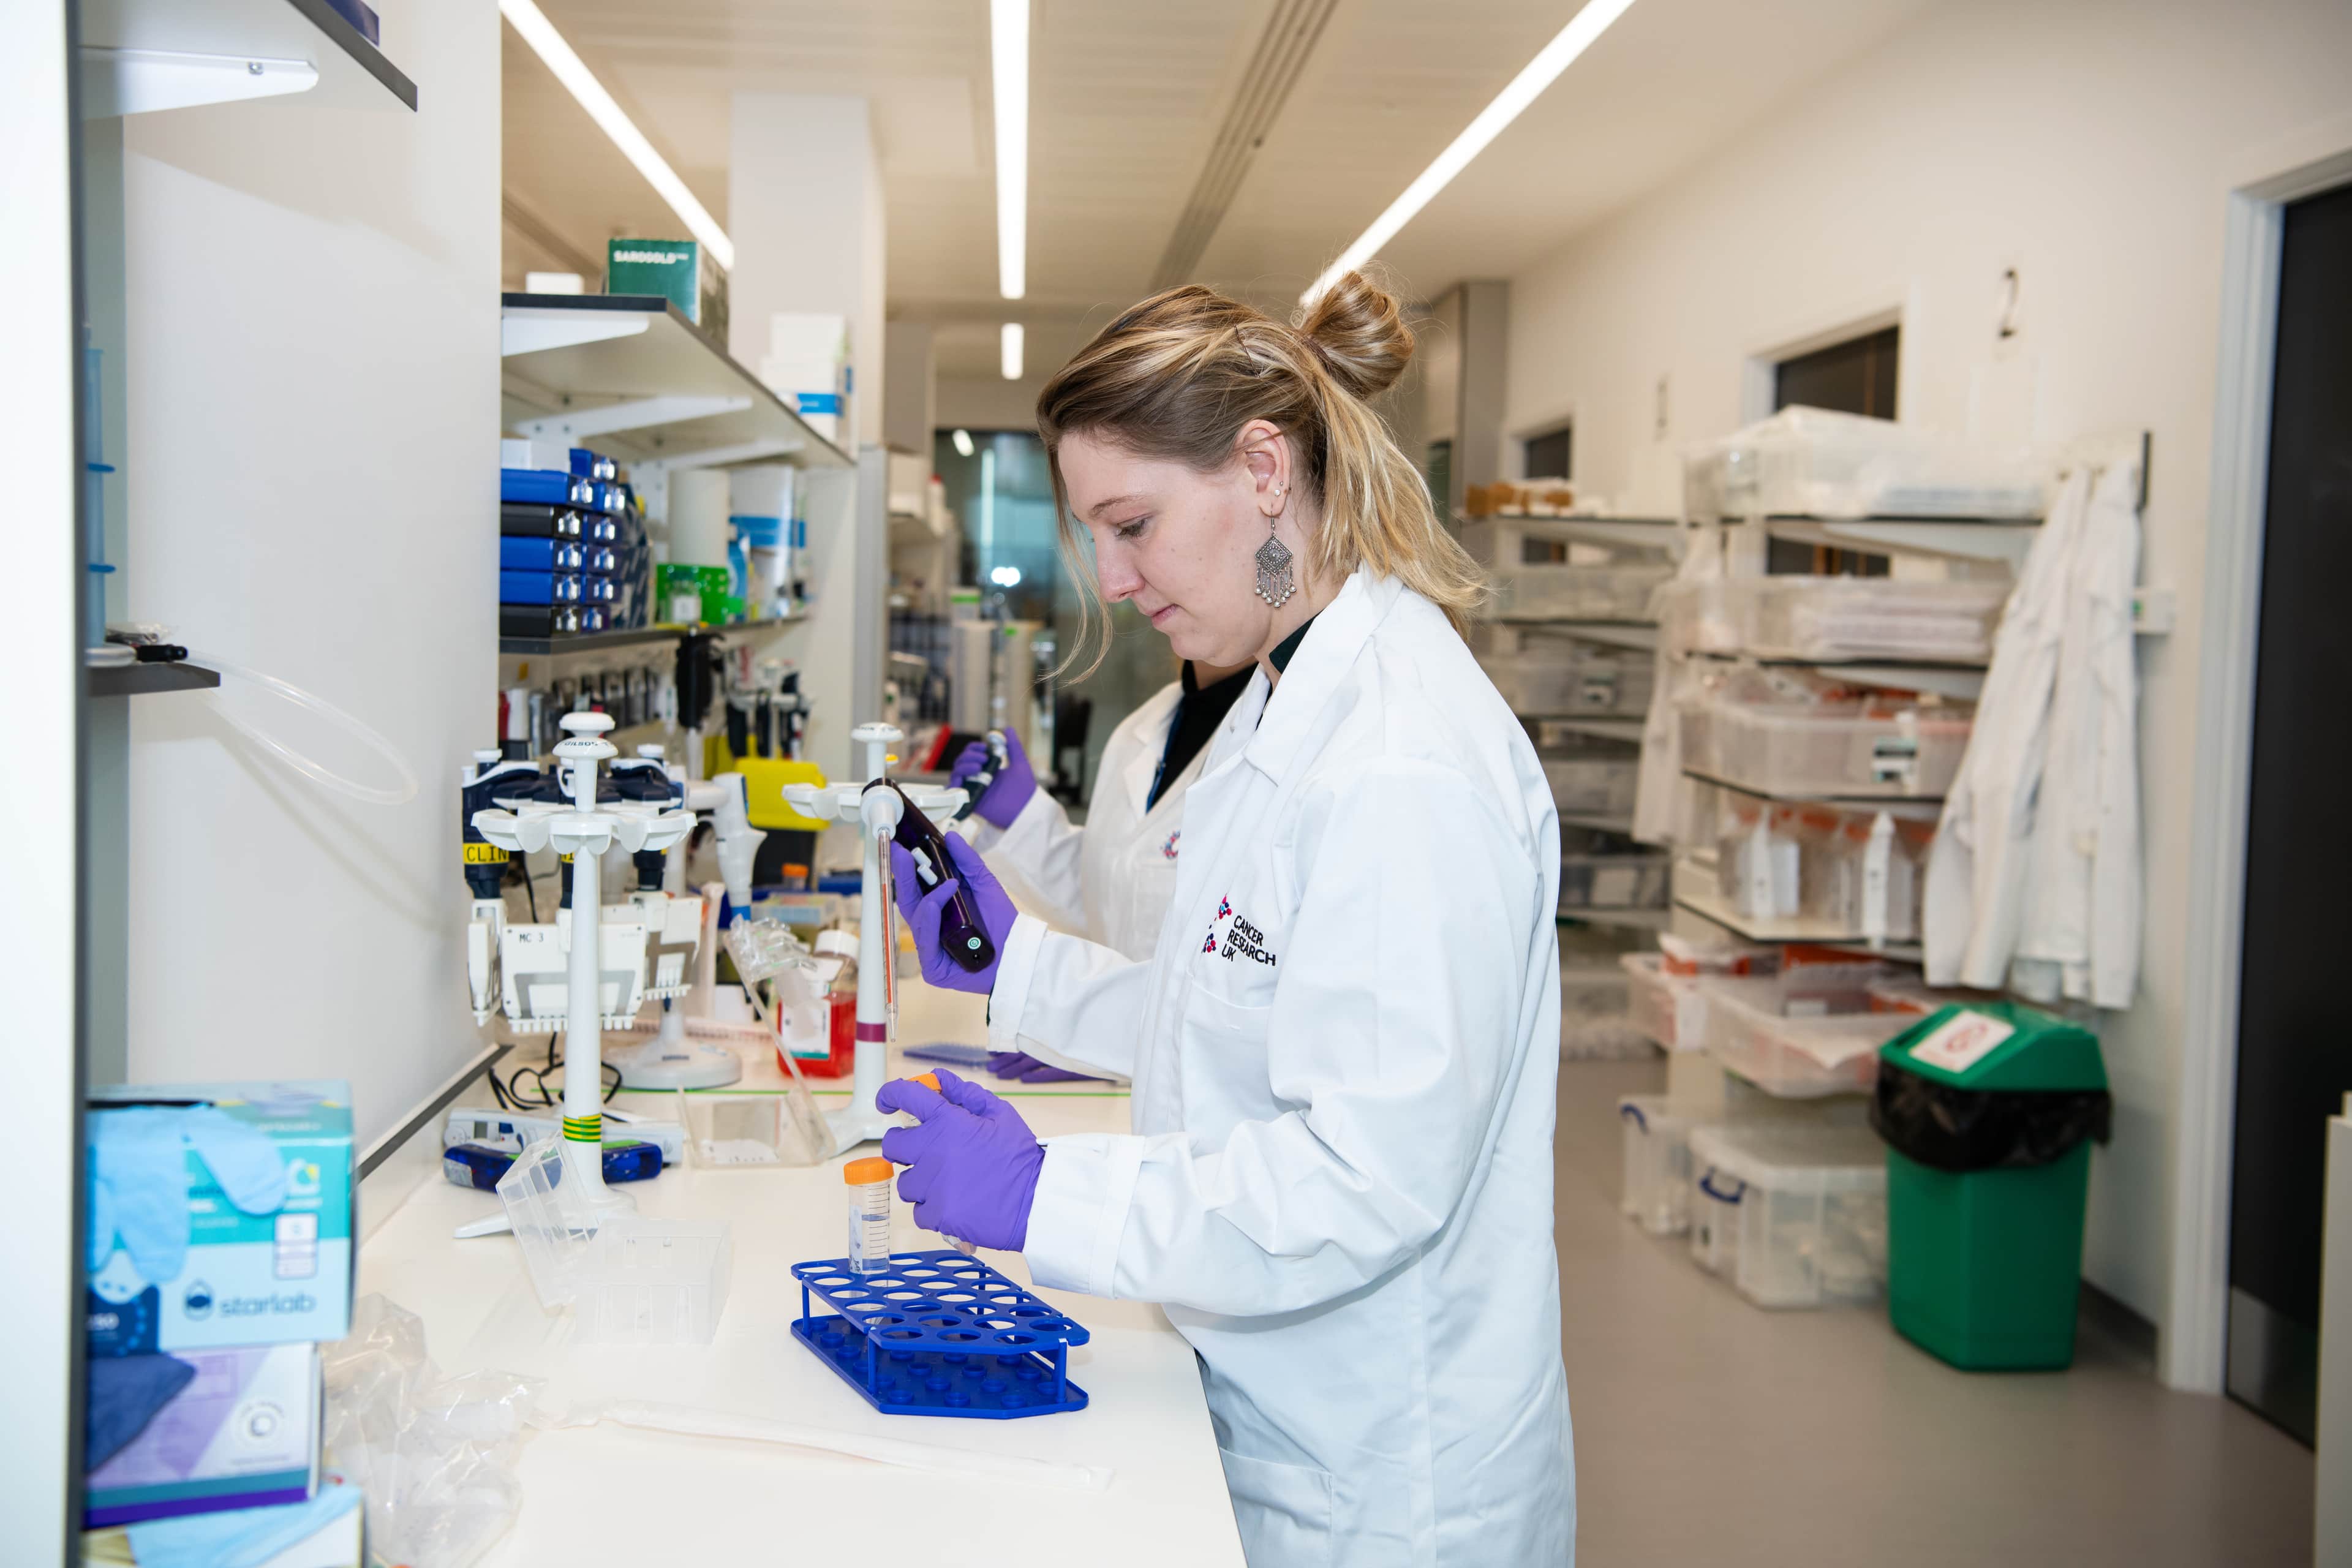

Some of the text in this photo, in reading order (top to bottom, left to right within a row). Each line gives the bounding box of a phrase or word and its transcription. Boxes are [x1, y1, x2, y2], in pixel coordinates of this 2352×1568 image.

[466, 846, 507, 862] CLIN
[519, 933, 544, 943] MC 3
[1234, 915, 1264, 946] CANCER
[1221, 943, 1237, 962] UK
[1227, 929, 1276, 967] RESEARCH
[221, 1291, 316, 1315] starlab
